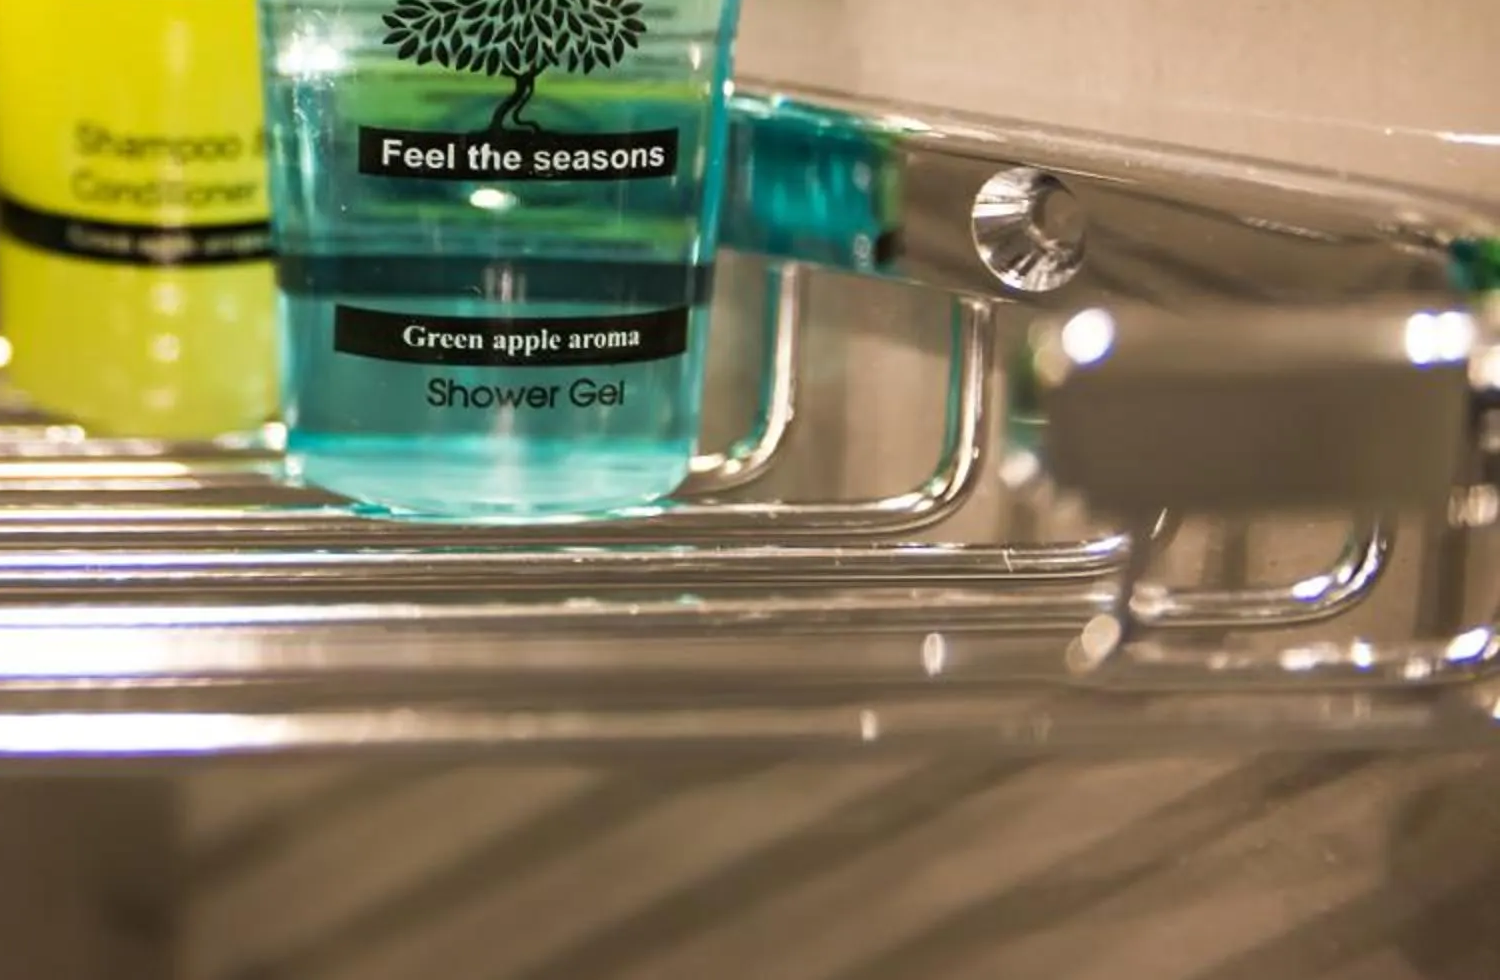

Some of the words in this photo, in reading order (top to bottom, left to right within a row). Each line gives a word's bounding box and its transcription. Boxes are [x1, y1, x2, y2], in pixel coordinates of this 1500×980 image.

[74, 121, 243, 164] Shampoo
[381, 138, 456, 170] Feel
[467, 142, 522, 171] the
[532, 145, 666, 171] seasons
[402, 324, 484, 350] Green
[492, 328, 562, 357] apple
[568, 328, 641, 350] aroma
[426, 376, 560, 409] Shower
[568, 377, 626, 407] Gel
